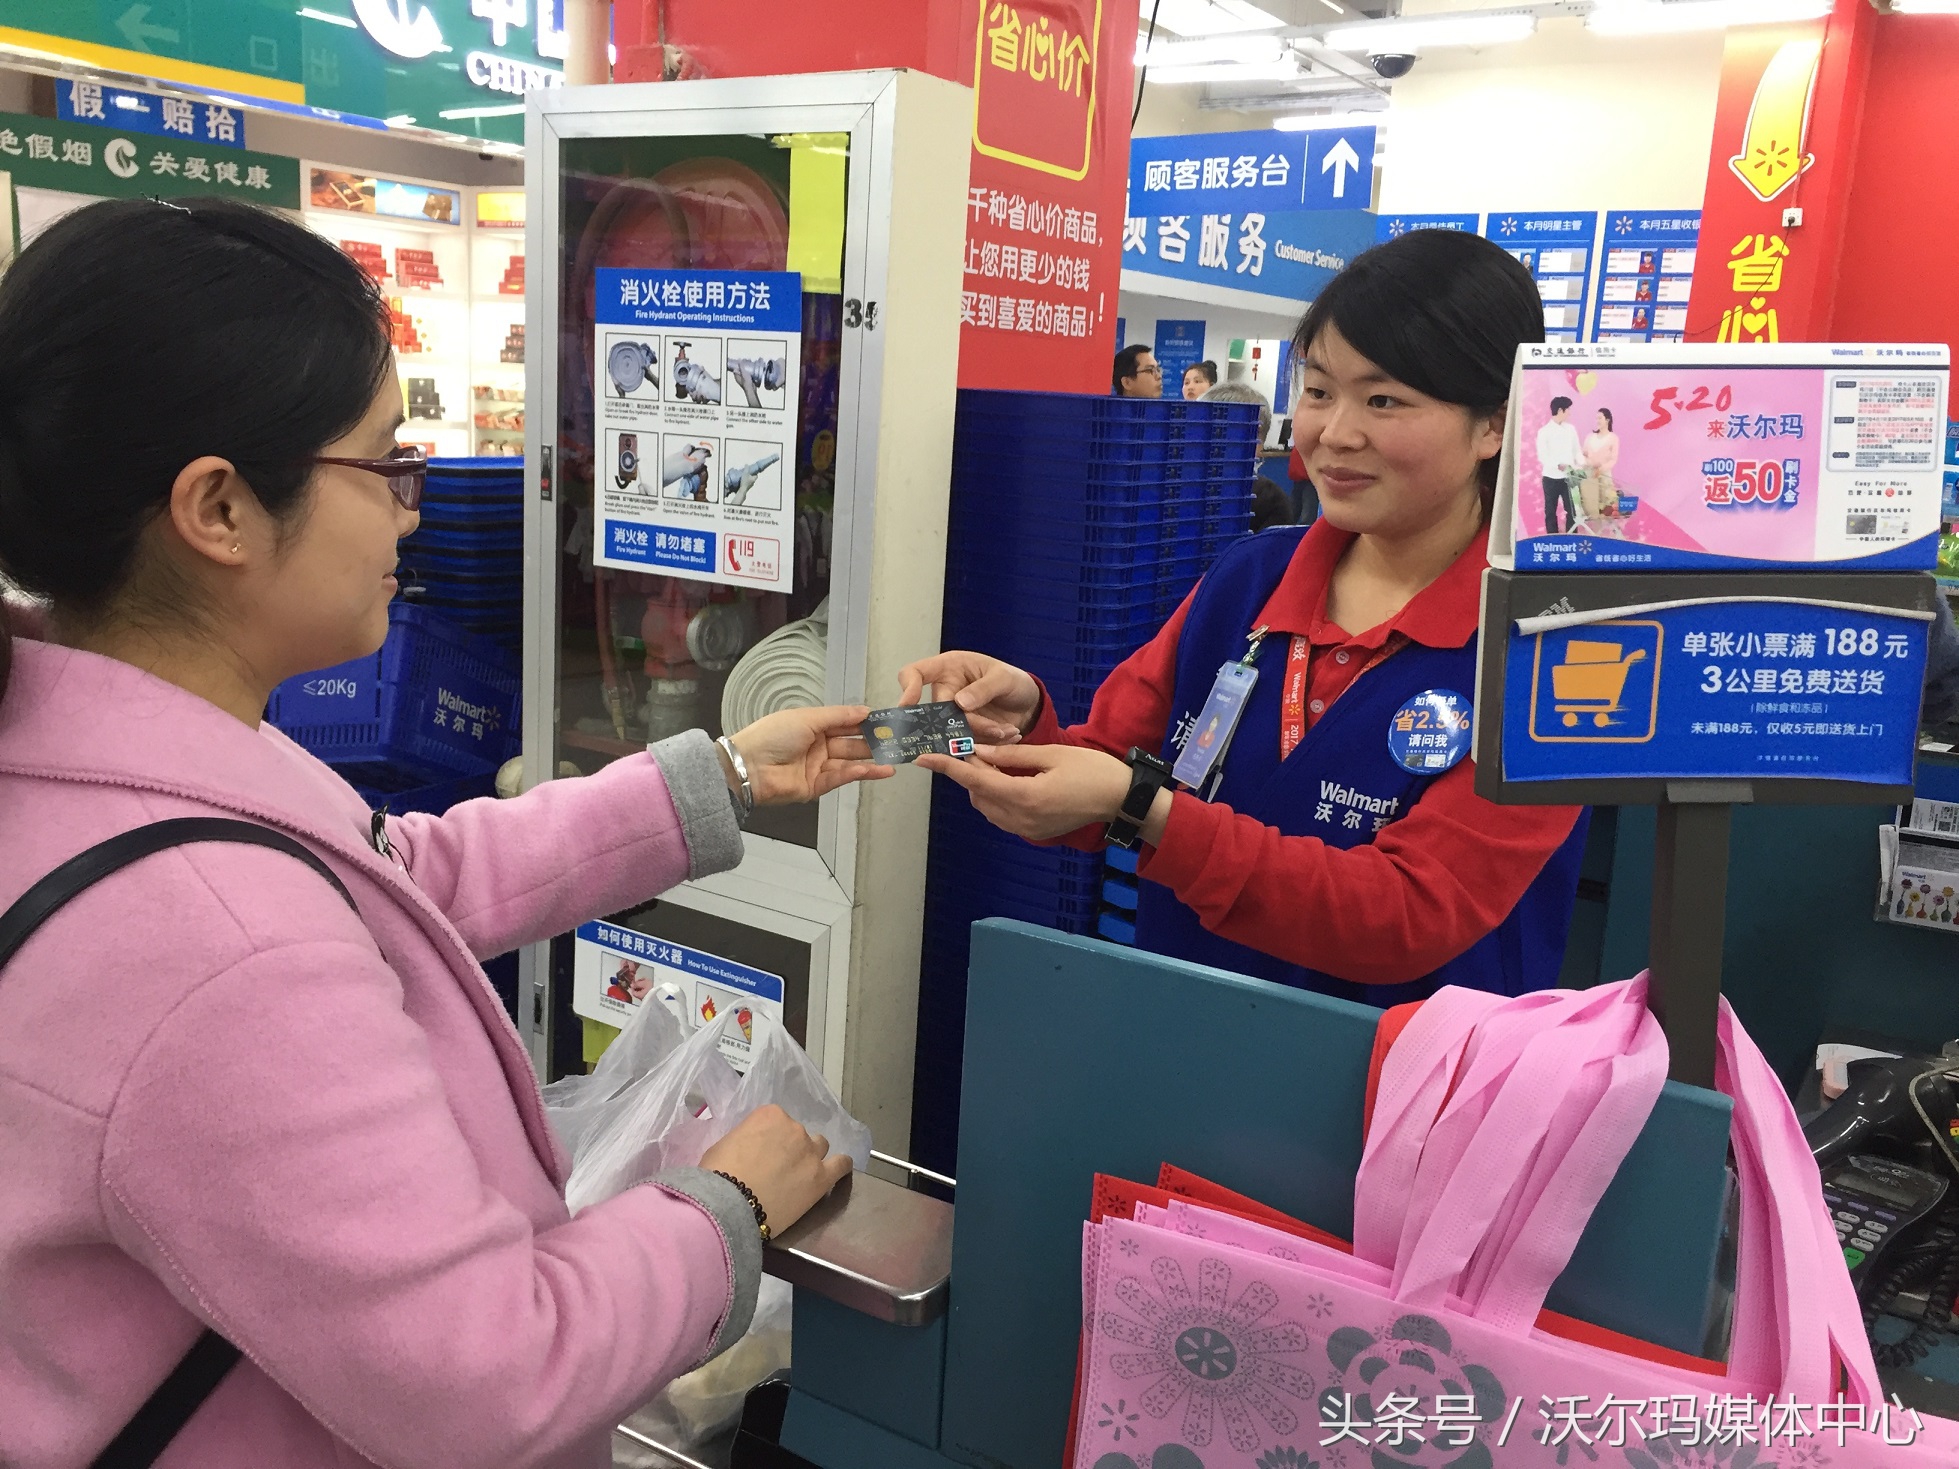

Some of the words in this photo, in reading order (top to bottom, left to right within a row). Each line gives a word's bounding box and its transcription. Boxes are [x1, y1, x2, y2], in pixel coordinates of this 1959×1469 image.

[988, 3, 1090, 97] 省心价
[69, 81, 237, 143] 假一赔拾
[150, 151, 272, 189] 关爱健康
[1144, 154, 1291, 192] 顾客服务台
[1523, 219, 1583, 232] 本月明星主管
[1275, 239, 1314, 265] Customer
[1314, 249, 1345, 271] Service
[620, 278, 771, 310] 消火栓使用方法
[635, 310, 648, 319] Fire
[649, 311, 676, 321] Hydrant
[677, 312, 712, 323] Operating
[712, 313, 755, 323] Instructions
[1832, 348, 1864, 356] Walmart
[1707, 414, 1804, 439] 来沃尔玛
[1784, 460, 1799, 503] 刷卡金
[614, 527, 648, 546] 消火栓
[655, 532, 706, 554] 请勿堵塞
[626, 547, 646, 556] Hydrant
[655, 550, 672, 559] Please
[672, 552, 680, 560] Do
[680, 553, 690, 561] Not
[739, 540, 755, 557] 119
[1533, 542, 1577, 552] Walmart
[1533, 553, 1577, 562] 沃尔玛
[1290, 672, 1302, 704] Walmart
[1701, 665, 1885, 695] 3公里免费送货
[438, 687, 487, 722] Walmart
[433, 708, 484, 741] 沃尔玛
[1290, 724, 1299, 745] 2017
[1408, 734, 1448, 748] 请问我
[1320, 780, 1399, 815] Walmart
[597, 926, 683, 966] 如何使用灭火器
[687, 958, 702, 969] How
[709, 966, 720, 975] Use
[720, 969, 757, 987] Extinguisher
